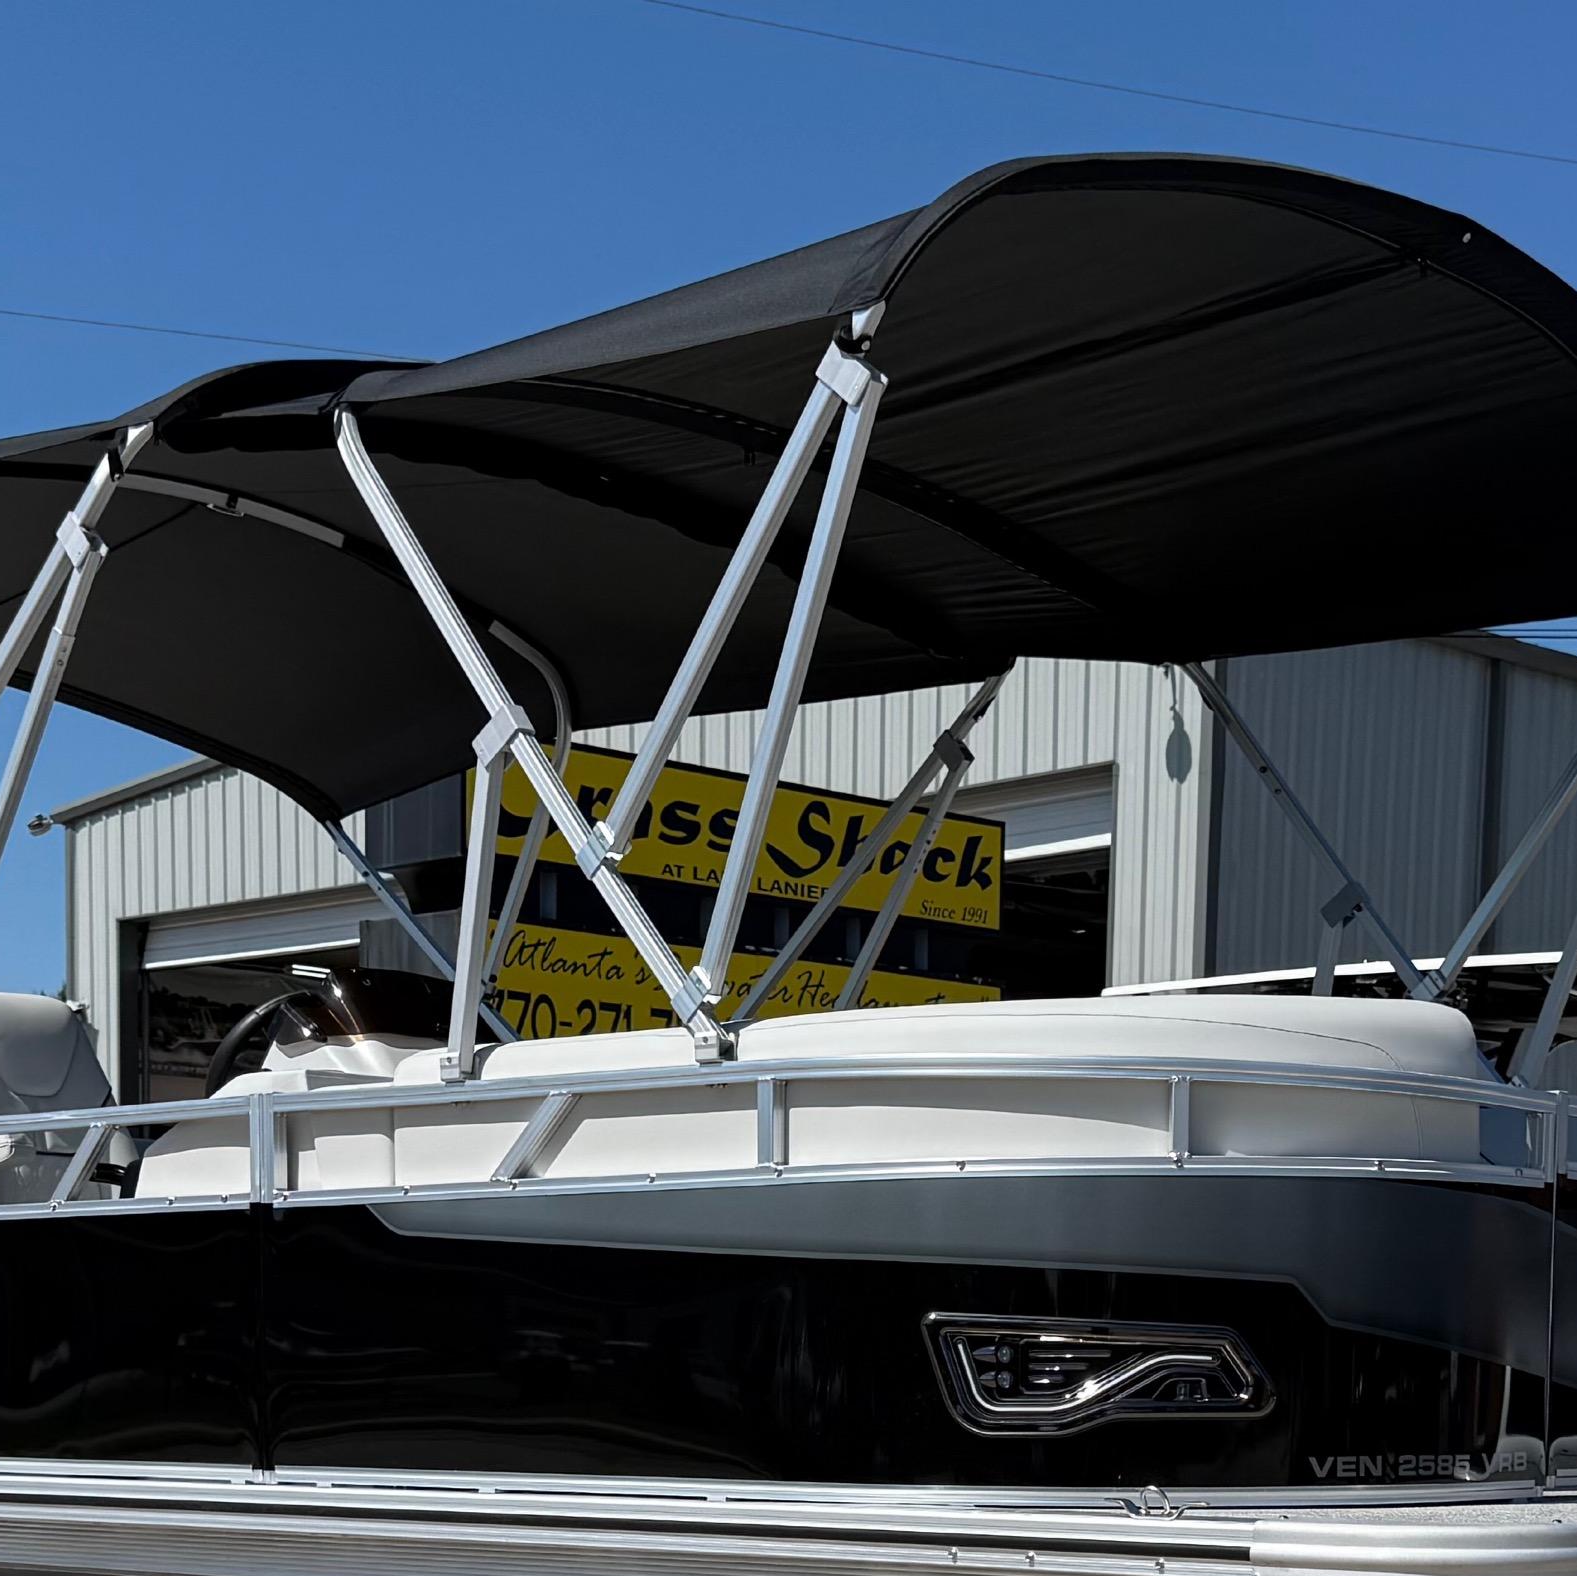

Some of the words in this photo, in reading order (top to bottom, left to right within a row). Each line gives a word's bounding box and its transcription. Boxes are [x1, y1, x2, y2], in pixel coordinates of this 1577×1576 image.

[661, 863, 685, 879] AT
[920, 899, 956, 920] Since
[961, 906, 989, 925] 1991
[1308, 1455, 1383, 1478] VEN
[1397, 1454, 1471, 1479] 2585
